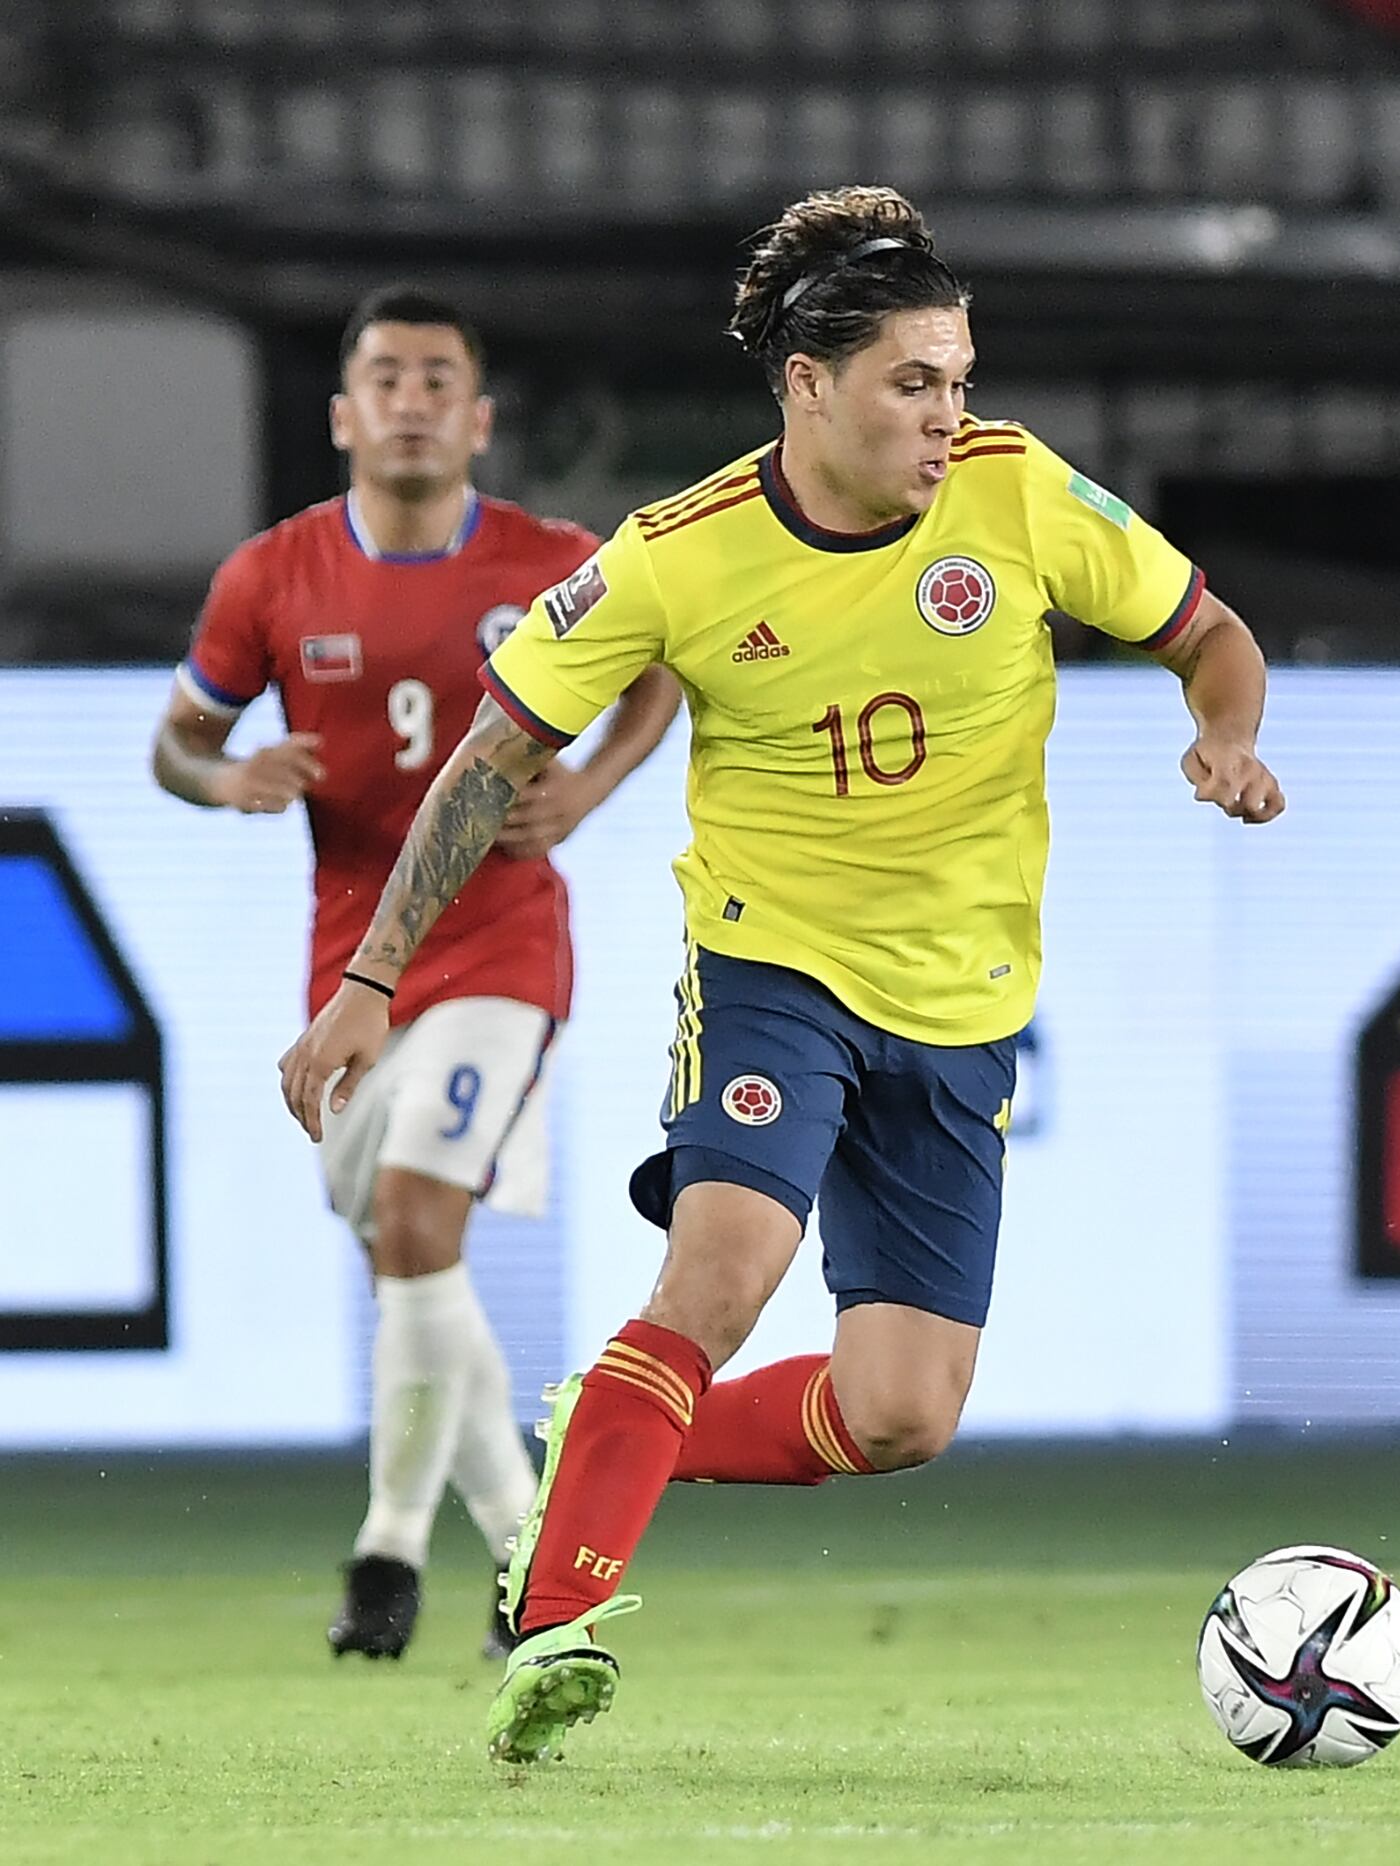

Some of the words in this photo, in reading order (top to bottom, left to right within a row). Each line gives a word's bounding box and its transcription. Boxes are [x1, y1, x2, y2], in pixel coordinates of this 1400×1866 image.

[732, 644, 790, 663] adidas
[387, 678, 433, 770] 9
[812, 691, 926, 796] 10
[440, 1063, 481, 1140] 9
[574, 1545, 624, 1580] FCF
